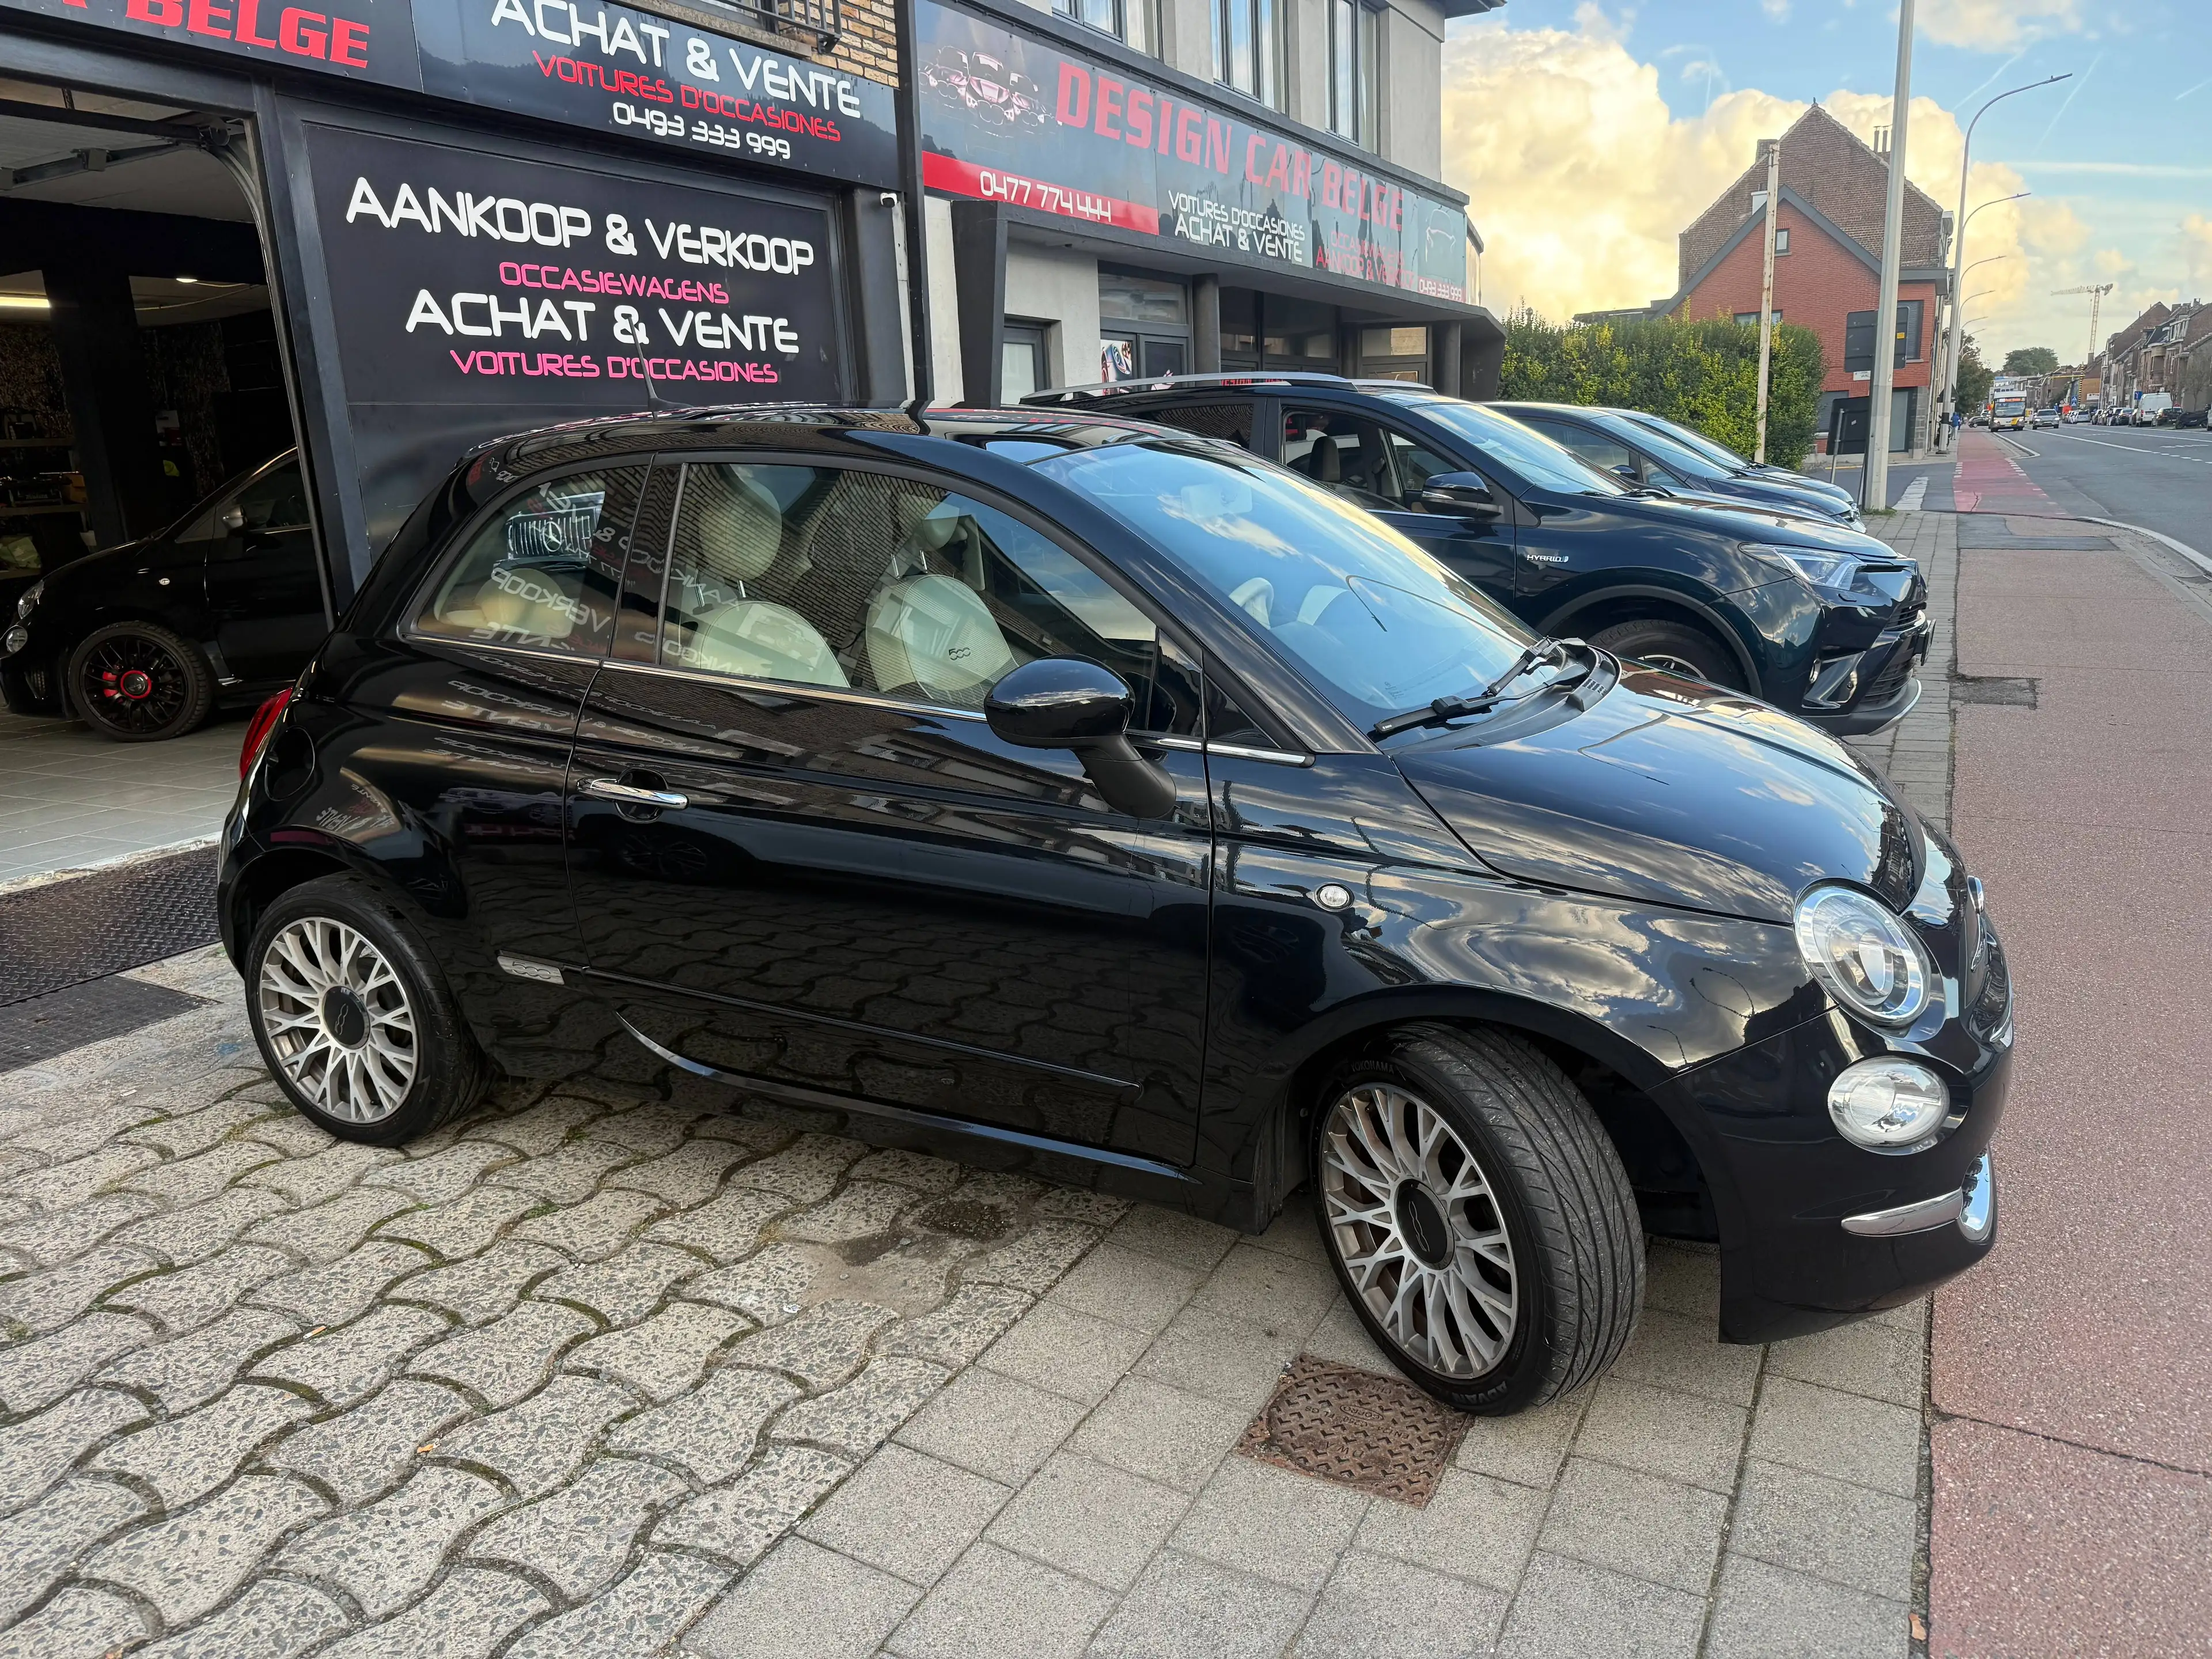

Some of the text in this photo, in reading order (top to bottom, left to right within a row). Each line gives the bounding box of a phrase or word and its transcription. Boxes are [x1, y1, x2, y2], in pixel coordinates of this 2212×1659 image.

[126, 0, 370, 69] BELGE
[491, 0, 861, 119] ACHAT & VENTE
[533, 50, 842, 142] VOITURES D'OCCASIONES
[613, 102, 791, 160] 0493 333 999
[1055, 61, 1403, 231] DESIGN CAR BELGE
[980, 171, 1112, 222] 0477 774 444
[1168, 190, 1305, 241] VOITURES D'OCCASIONES
[346, 177, 814, 275] AANKOOP & VERKOOP
[1174, 213, 1302, 263] ACHAT & VENTE
[499, 262, 729, 304] OCCASIEWAGENS
[1419, 278, 1463, 302] 0493 333 999
[405, 289, 799, 353] ACHAT & VENTE
[450, 350, 778, 383] VOITURES D'OCCASIONES
[1527, 554, 1562, 563] HYBRID
[948, 647, 971, 661] 500
[512, 961, 551, 979] 500
[1350, 1060, 1394, 1075] YOKOHAMA
[1342, 1405, 1382, 1421] COPRO
[1451, 1380, 1508, 1404] ADVAN
